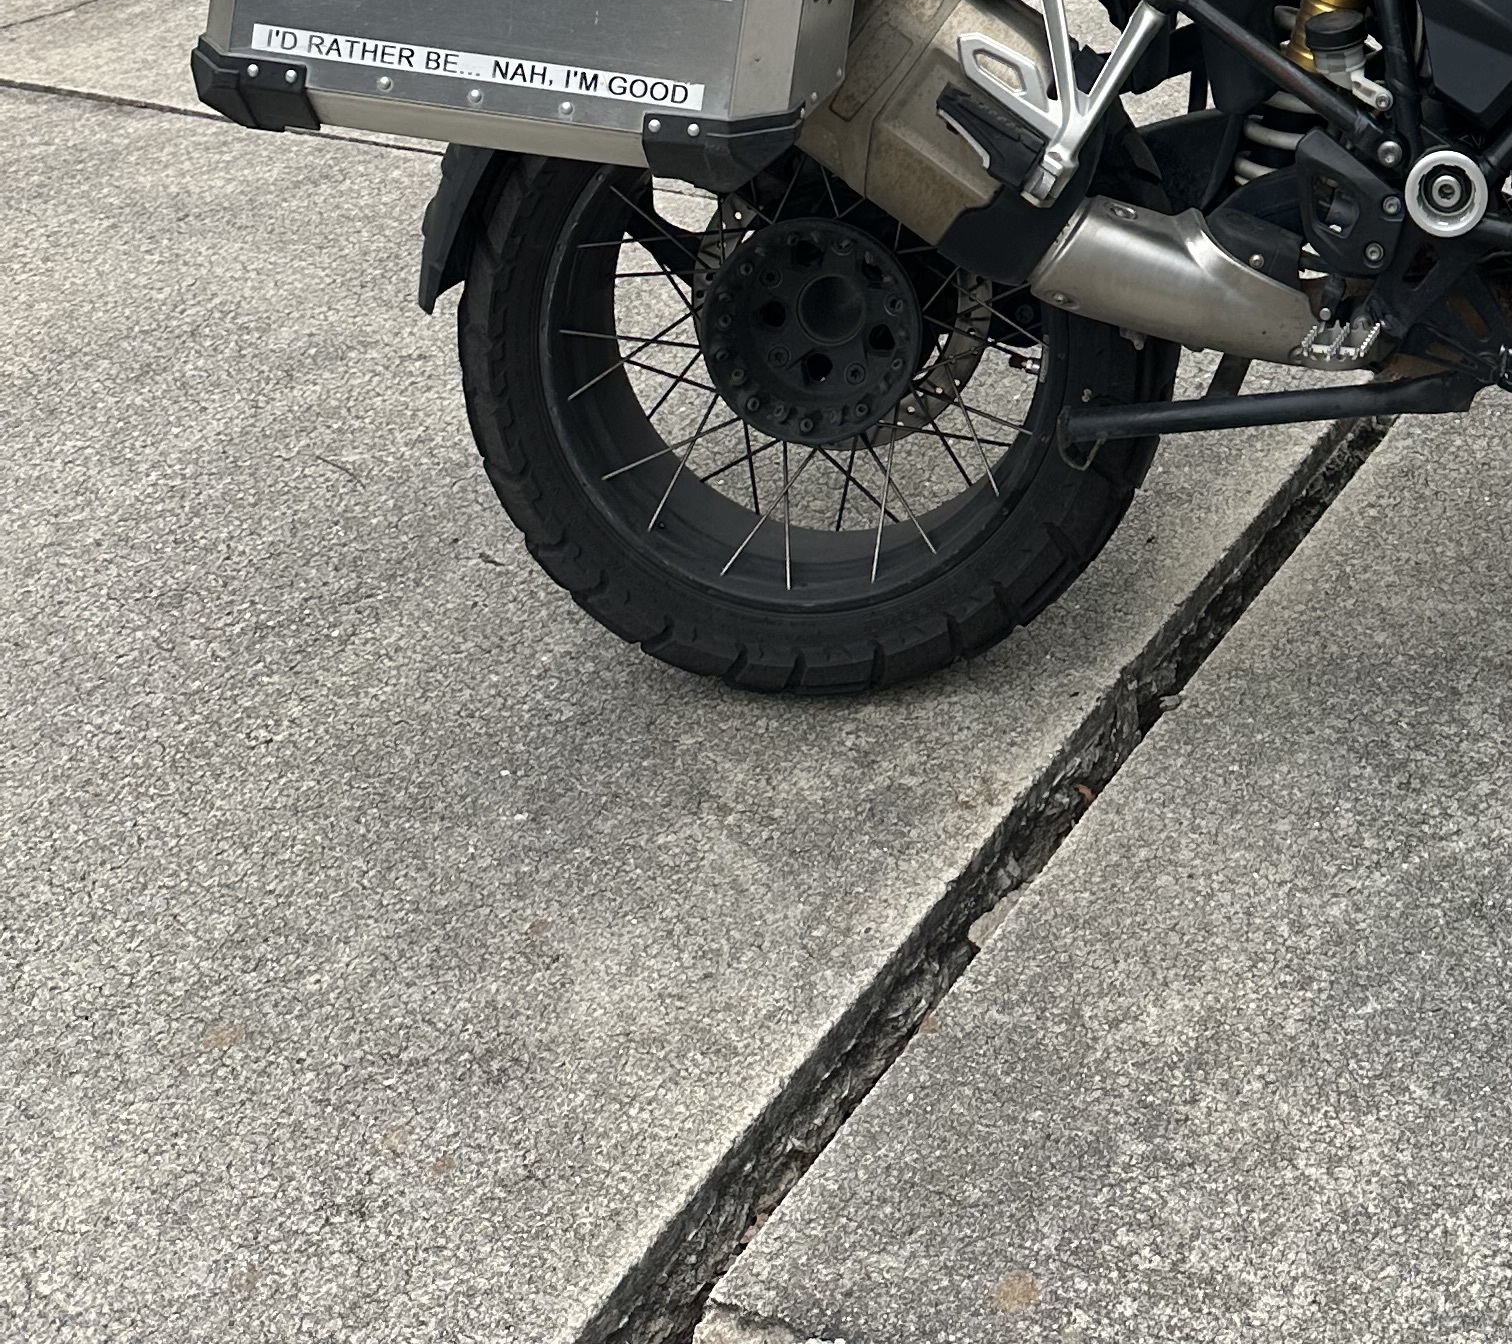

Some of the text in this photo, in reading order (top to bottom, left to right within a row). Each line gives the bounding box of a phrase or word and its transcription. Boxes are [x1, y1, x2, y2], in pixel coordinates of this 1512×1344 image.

[266, 28, 689, 104] I'D RATHER BE... NAH, I'M GOOD
